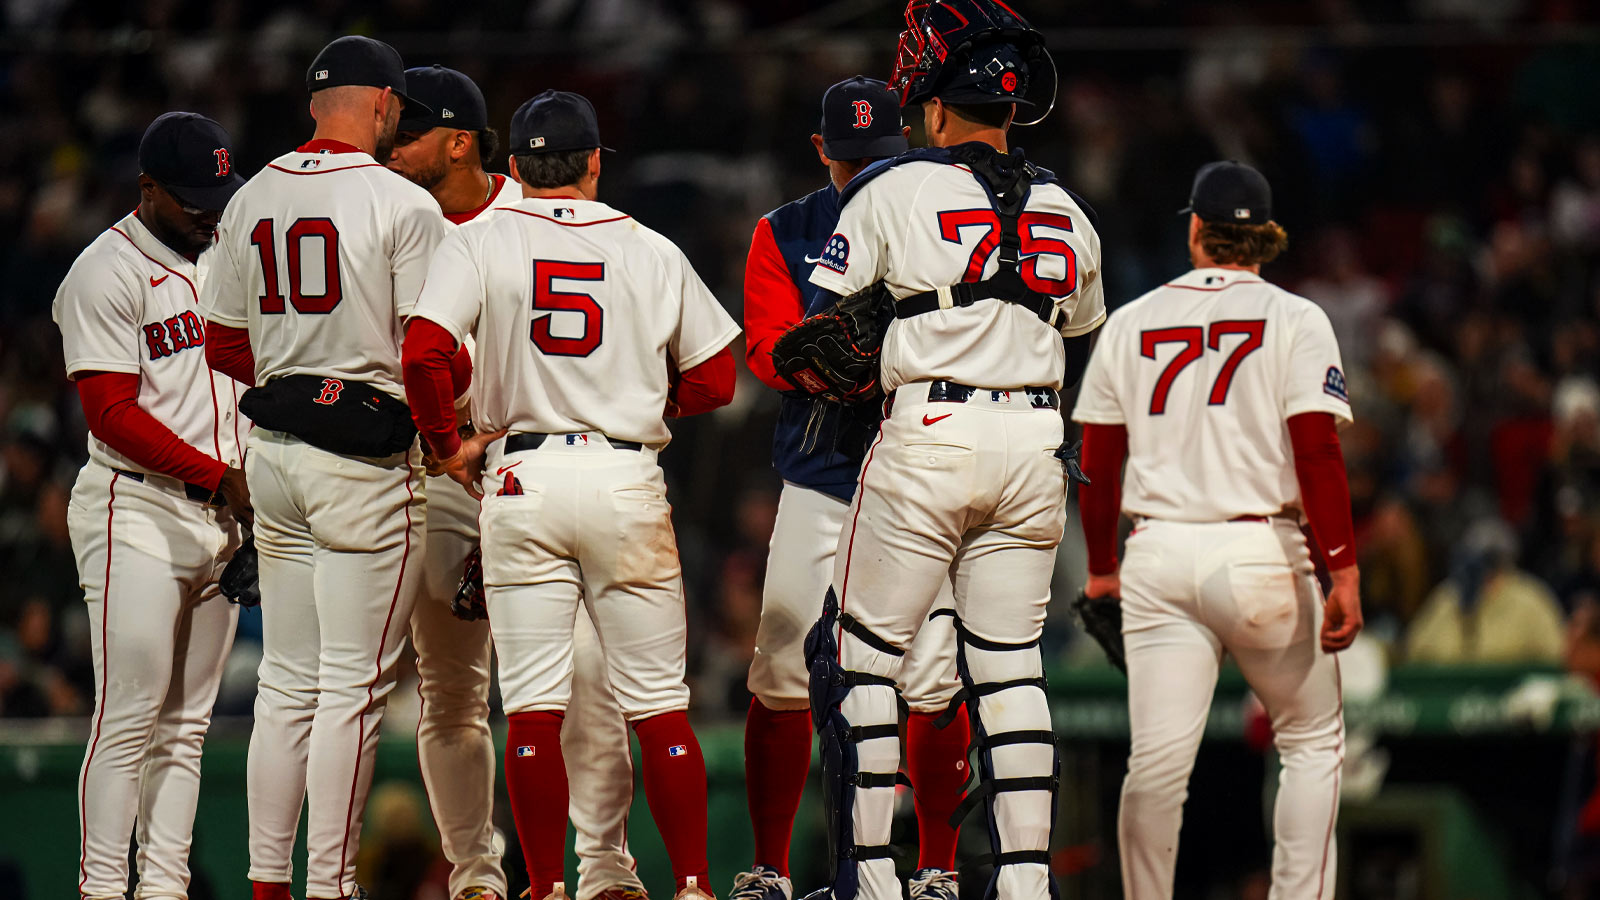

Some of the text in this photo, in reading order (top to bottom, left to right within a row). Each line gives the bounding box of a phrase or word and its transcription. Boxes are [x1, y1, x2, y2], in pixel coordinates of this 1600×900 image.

[852, 100, 874, 128] B
[213, 148, 230, 177] B
[251, 217, 343, 314] 10
[937, 208, 1077, 298] 75
[142, 310, 204, 360] RED
[530, 259, 605, 358] 5
[313, 378, 344, 405] B
[1140, 319, 1267, 416] 77
